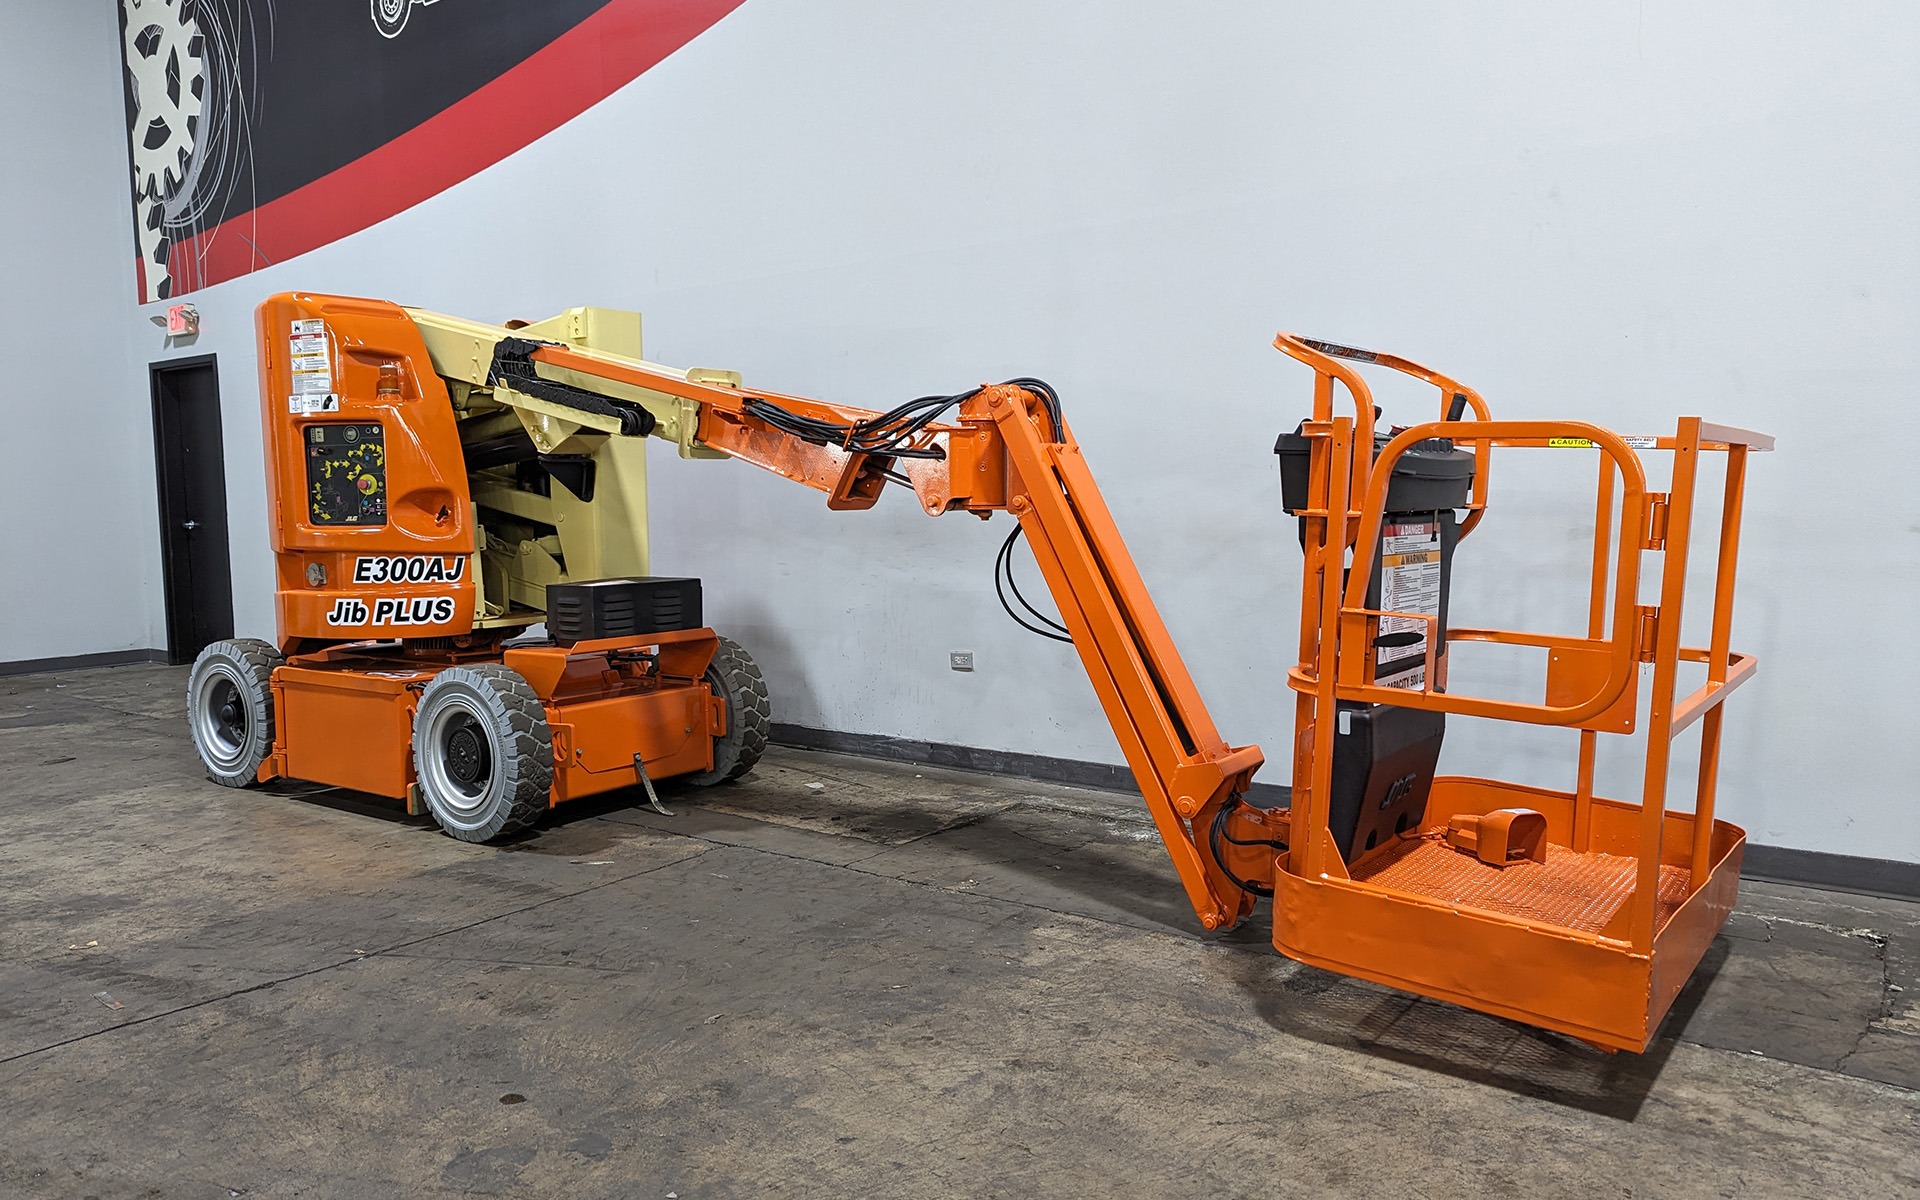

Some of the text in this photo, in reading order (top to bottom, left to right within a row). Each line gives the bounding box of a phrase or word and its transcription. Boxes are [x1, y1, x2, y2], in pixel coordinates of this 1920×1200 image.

[1405, 524, 1424, 535] DANGER
[1405, 552, 1428, 565] WARNING
[354, 557, 465, 582] E300AJ
[329, 599, 452, 623] Jib PLUS
